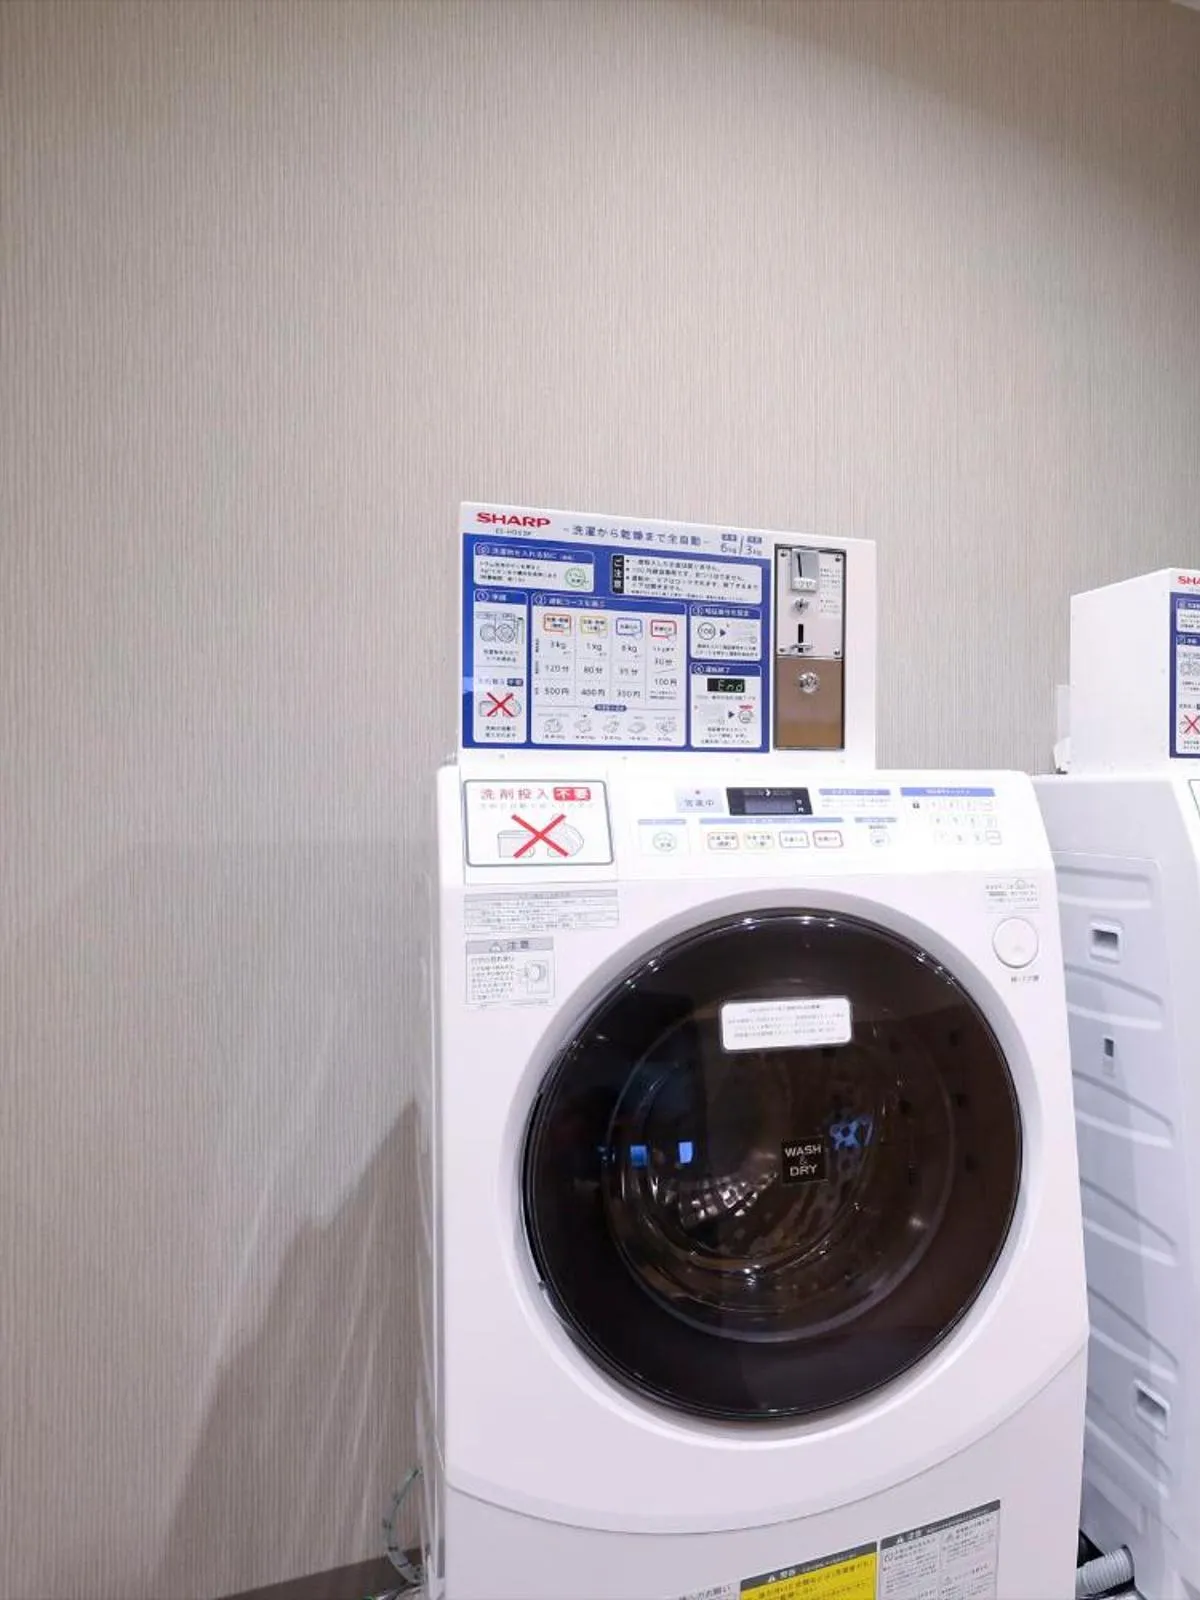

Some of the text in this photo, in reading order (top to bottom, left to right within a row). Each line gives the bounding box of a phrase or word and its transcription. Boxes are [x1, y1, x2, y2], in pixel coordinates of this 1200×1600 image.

[476, 512, 551, 528] SHARP
[784, 1143, 822, 1158] WASH
[789, 1165, 818, 1177] DRY
